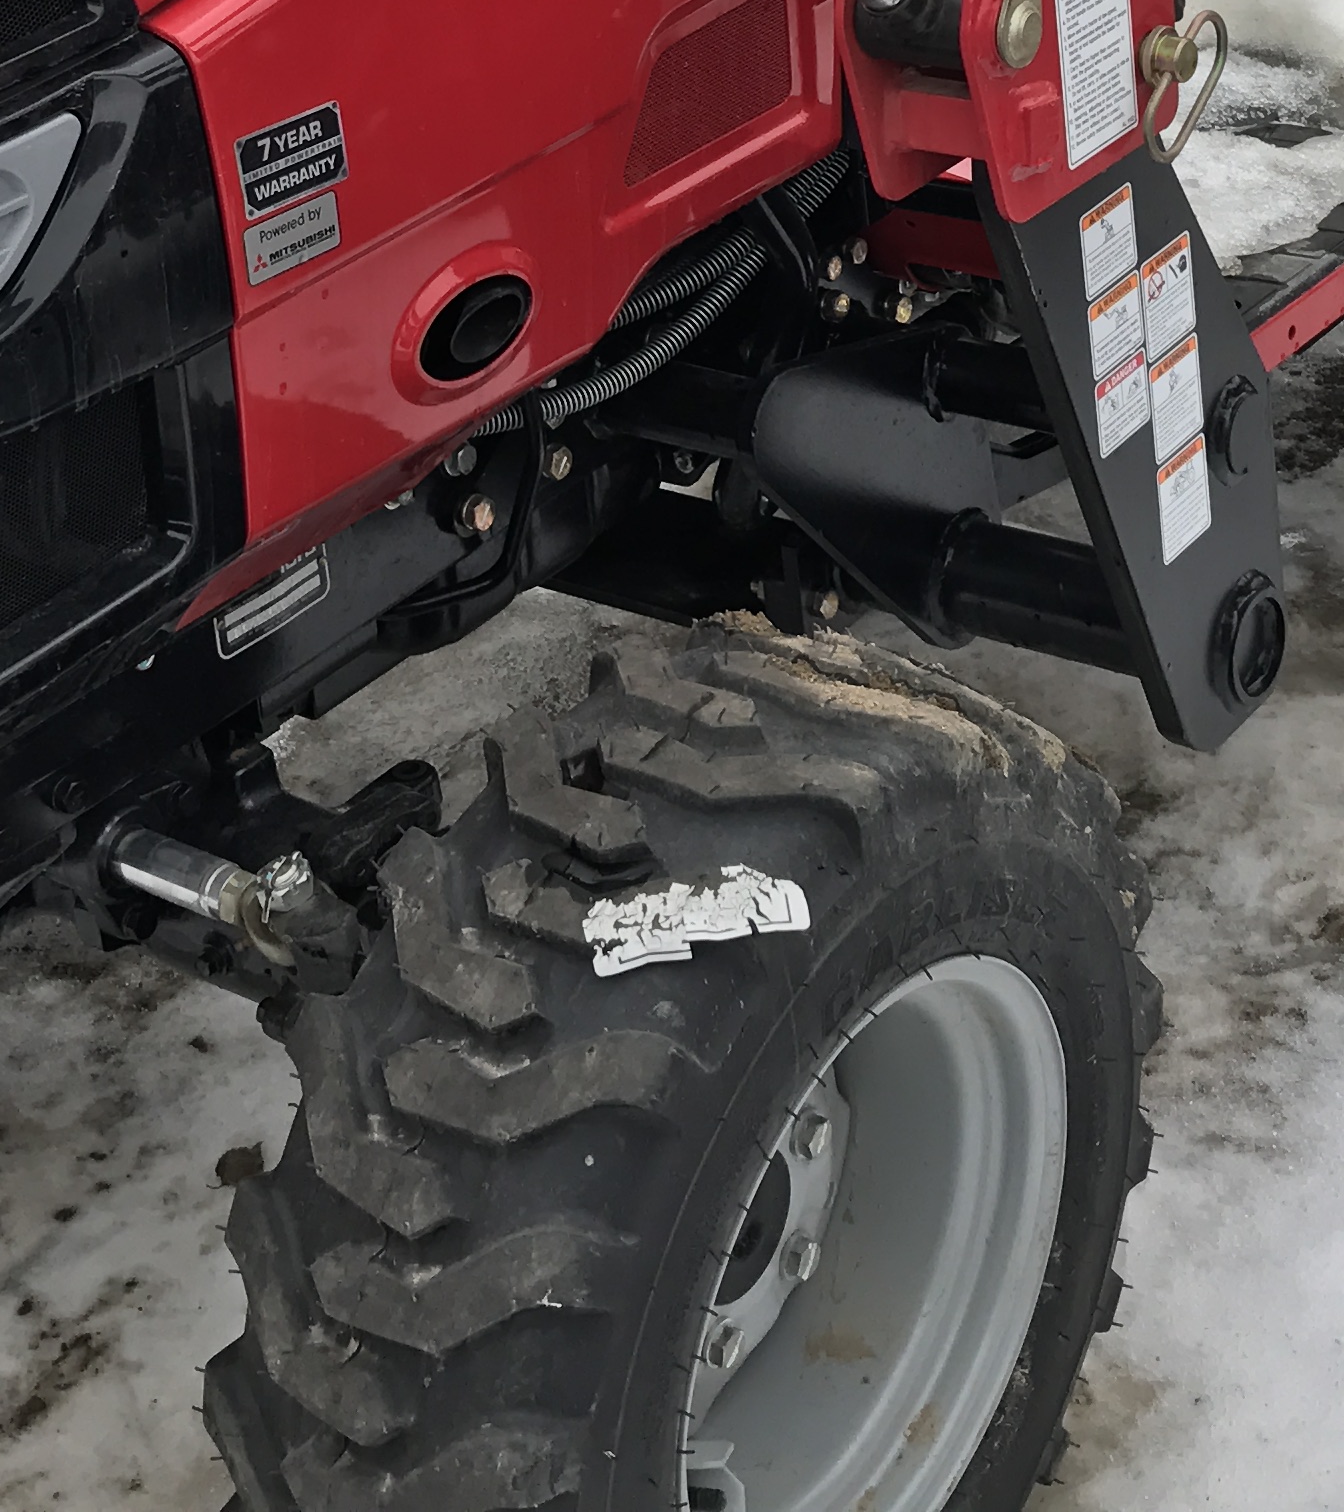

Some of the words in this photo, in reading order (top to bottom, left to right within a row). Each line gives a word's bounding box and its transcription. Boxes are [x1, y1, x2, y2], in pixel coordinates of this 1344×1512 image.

[256, 138, 272, 161] 7
[275, 120, 323, 153] YEAR
[254, 154, 337, 201] WARRANTY
[259, 212, 305, 244] Powered
[308, 206, 322, 221] by
[268, 223, 337, 261] MITSUBISHI
[1111, 358, 1138, 385] DANGER
